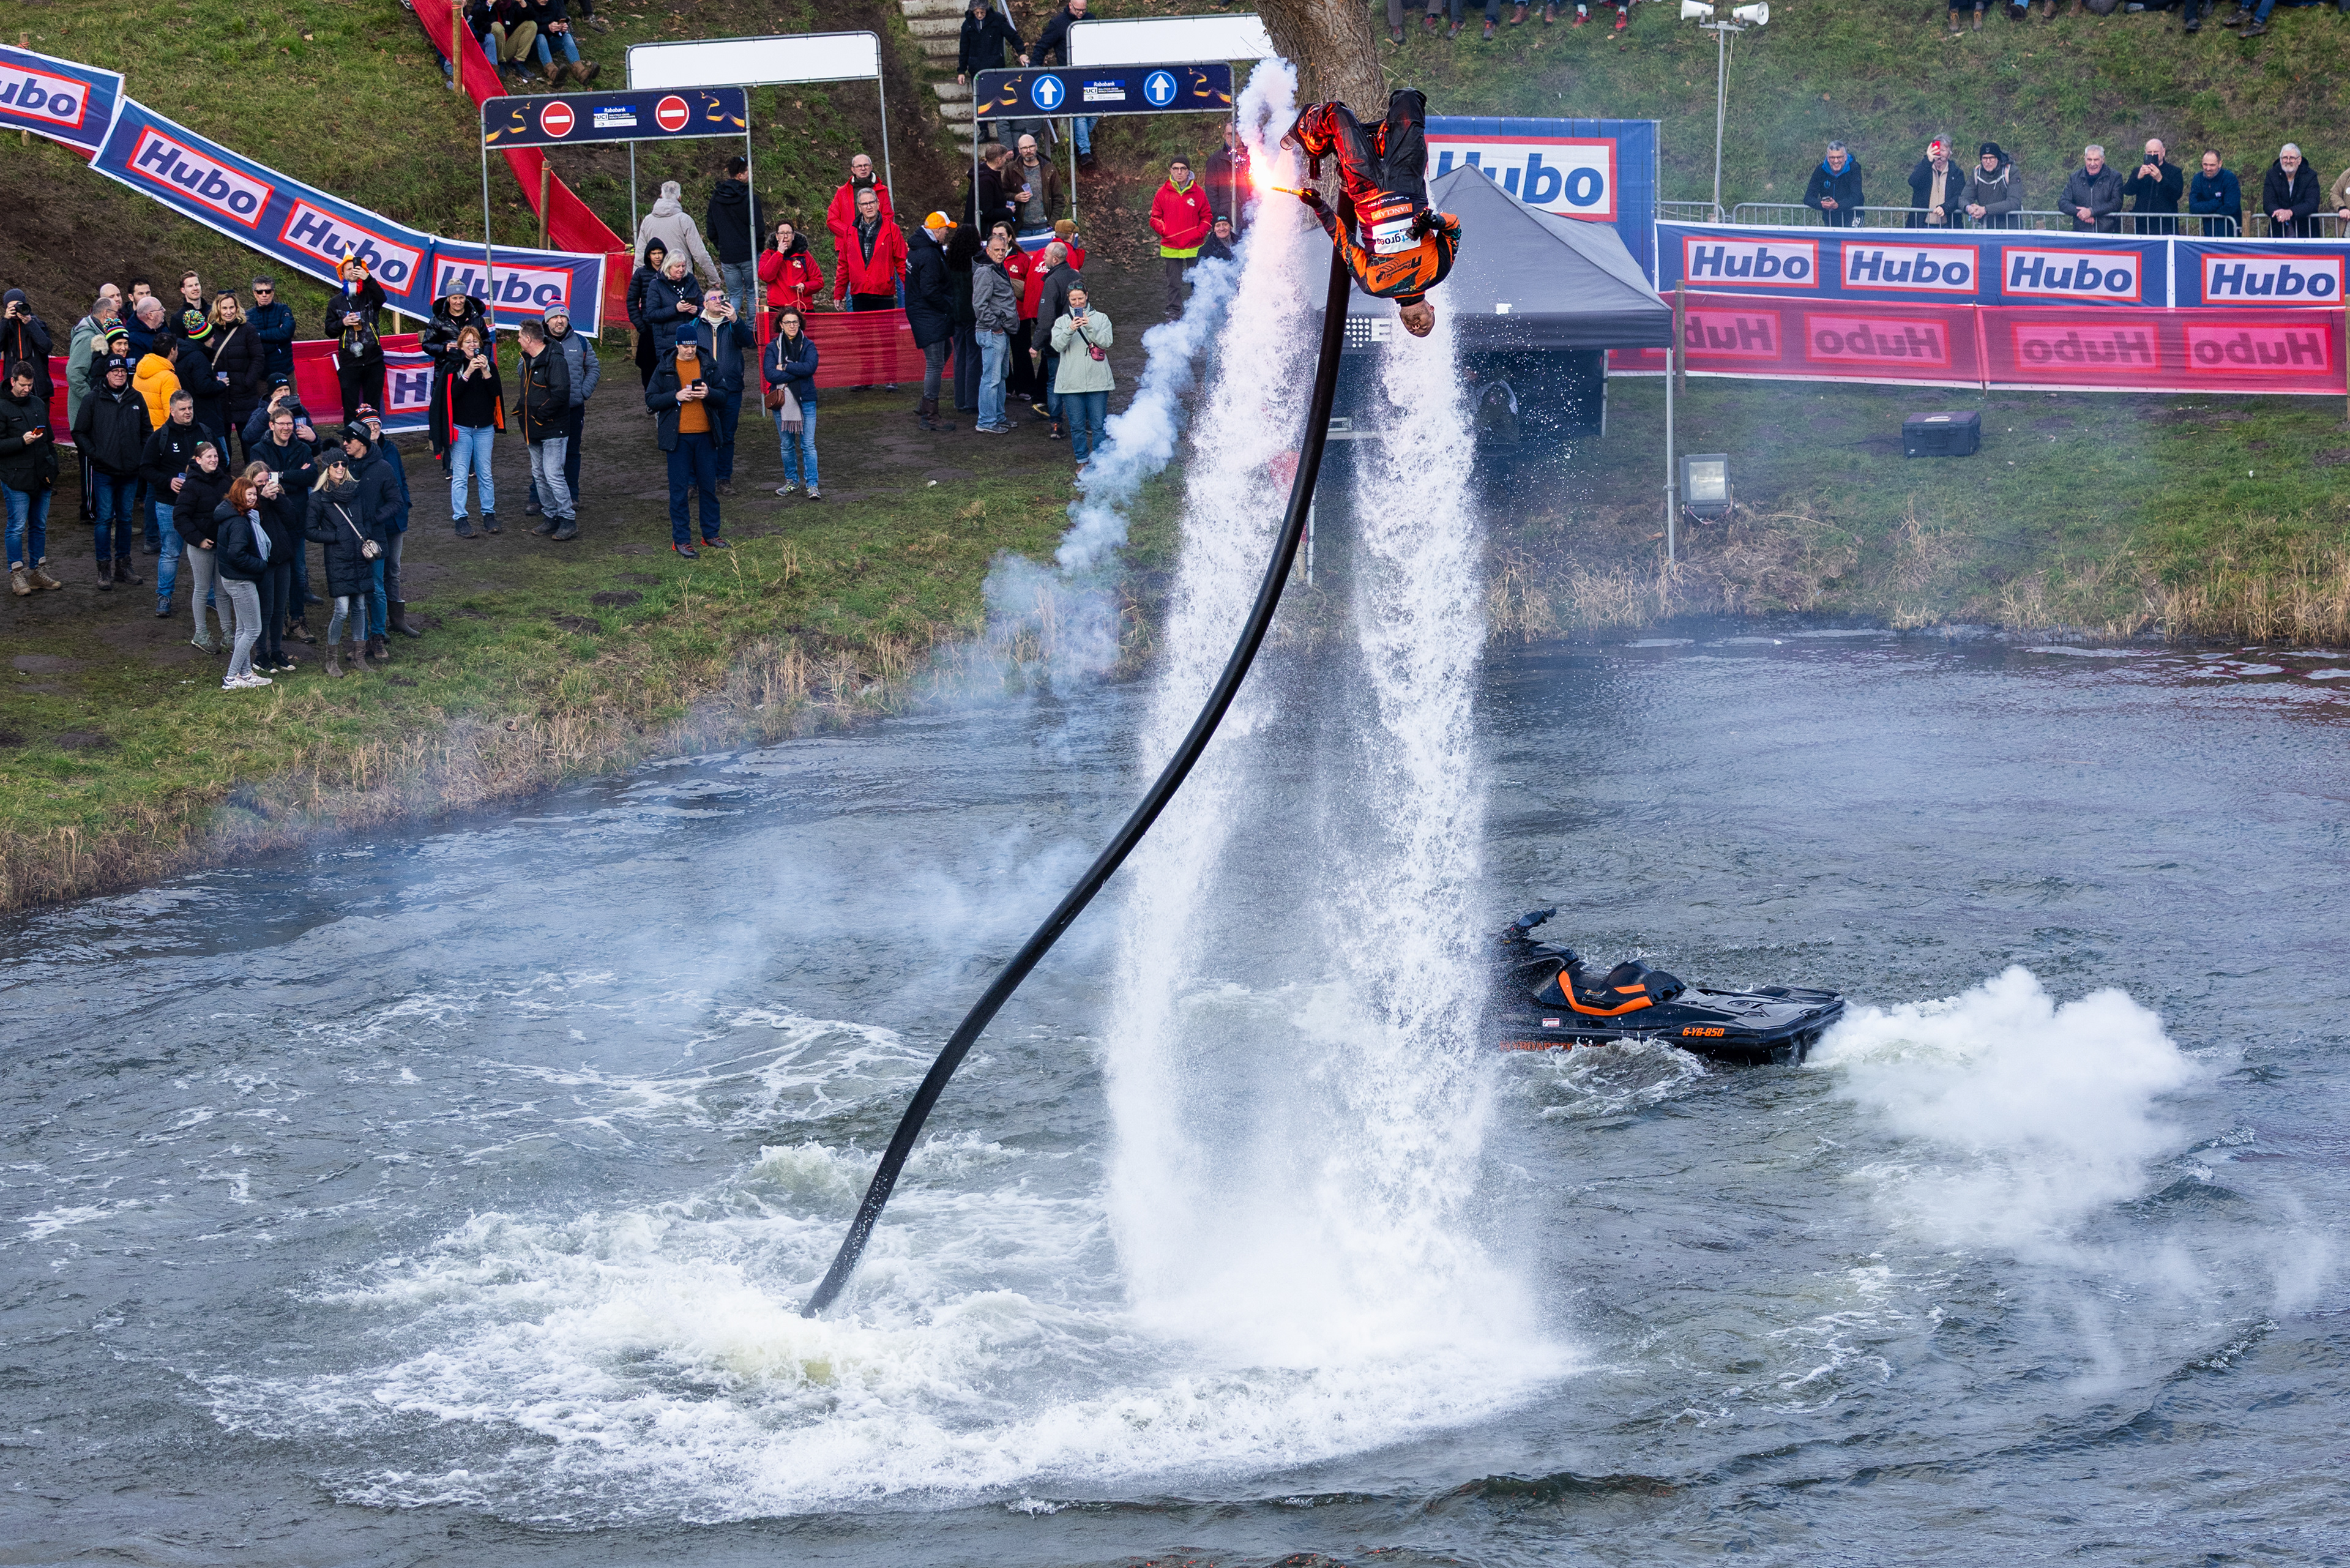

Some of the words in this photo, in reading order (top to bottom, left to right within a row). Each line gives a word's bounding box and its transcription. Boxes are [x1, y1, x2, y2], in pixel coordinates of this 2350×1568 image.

[138, 139, 258, 214] Hubo
[289, 211, 408, 283] Hubo
[1692, 246, 1810, 280] Hubo
[438, 266, 562, 306] Hubo
[1848, 250, 1971, 286] Hubo
[2010, 256, 2133, 293] Hubo
[2210, 263, 2336, 297] Hubo
[1682, 1027, 1725, 1037] 6-YB-850
